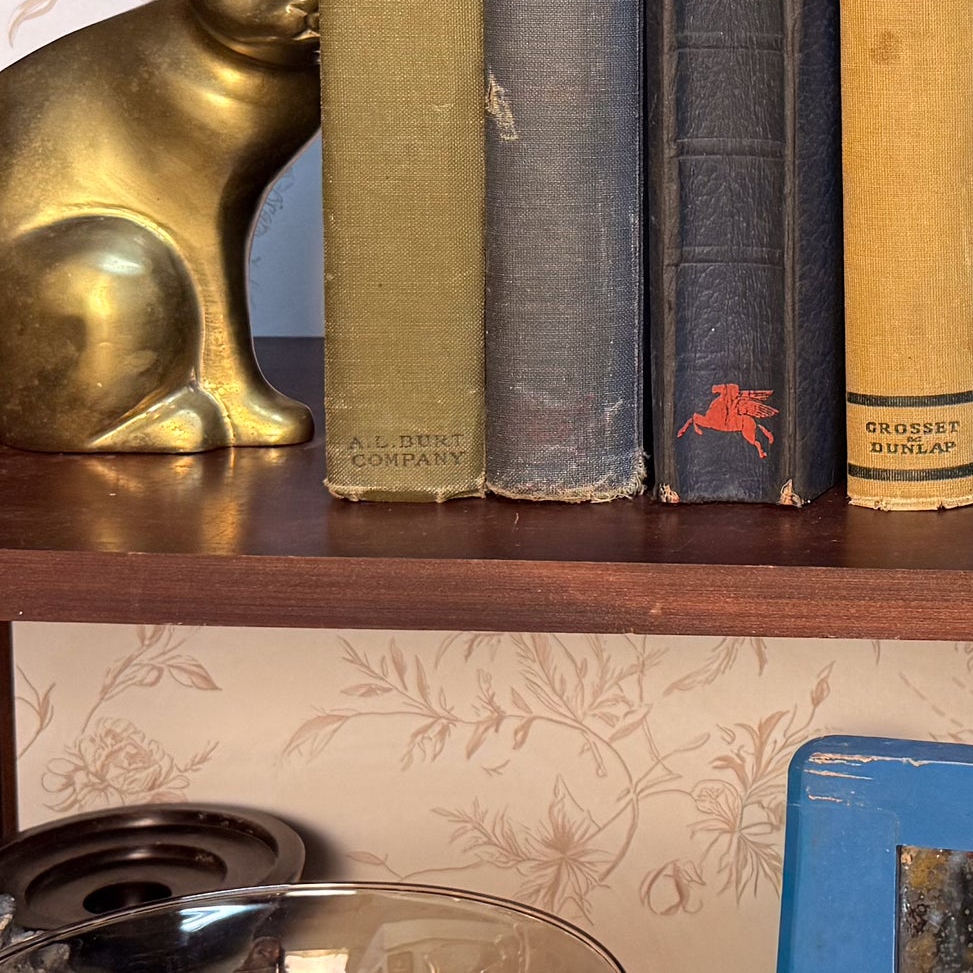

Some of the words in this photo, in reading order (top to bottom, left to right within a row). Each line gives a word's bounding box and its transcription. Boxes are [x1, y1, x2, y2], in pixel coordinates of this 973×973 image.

[866, 421, 960, 435] GROSSET
[869, 442, 957, 455] DUNLAP
[352, 452, 465, 468] COMPANY
